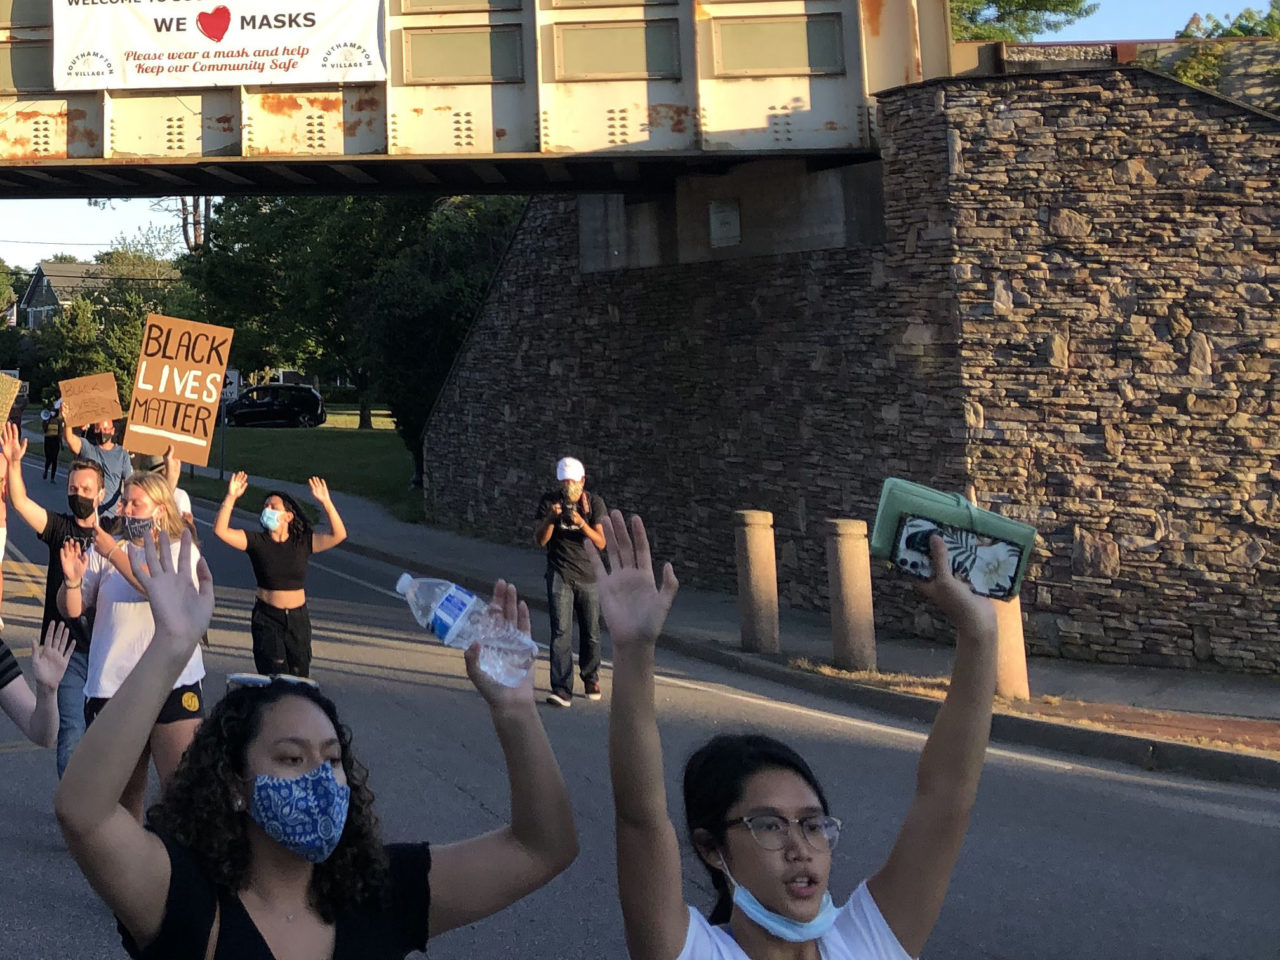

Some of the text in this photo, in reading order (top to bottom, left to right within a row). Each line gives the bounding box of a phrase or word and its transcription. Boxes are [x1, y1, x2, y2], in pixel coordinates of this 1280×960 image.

[154, 12, 316, 32] WE MASKS
[67, 51, 114, 76] SOUTHAMPTON
[124, 45, 309, 61] Please wear a mask and help
[321, 42, 373, 68] SOUTHAMPTON
[135, 58, 298, 76] Keep our Community Safe
[144, 323, 228, 366] BLACK
[138, 360, 221, 403] LIVES
[131, 397, 211, 437] MATTER
